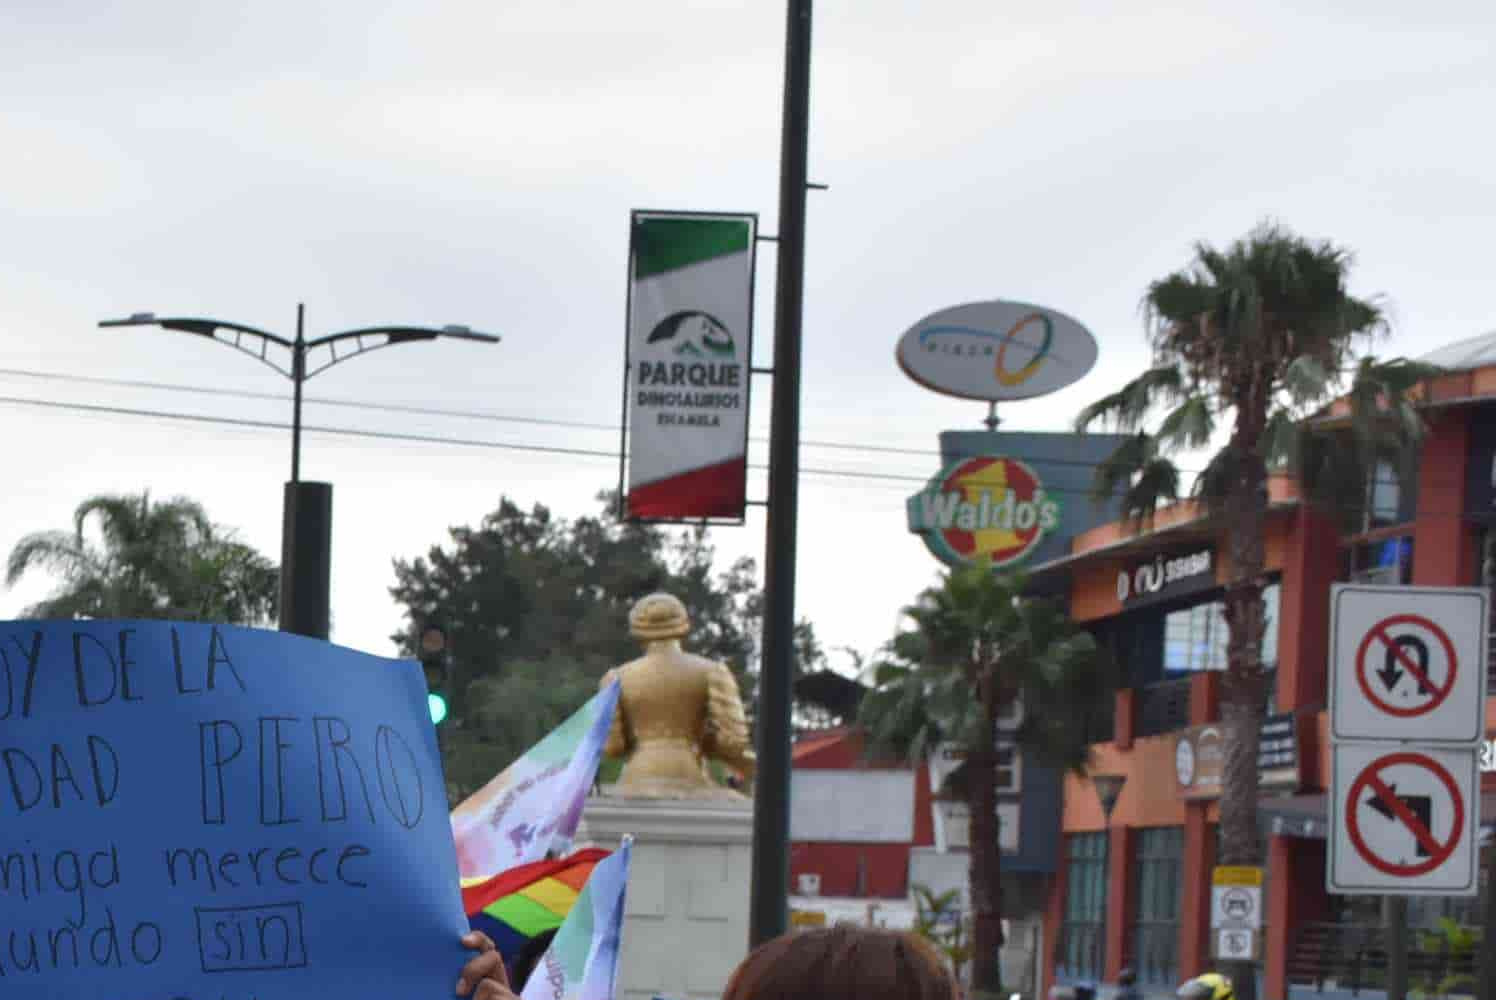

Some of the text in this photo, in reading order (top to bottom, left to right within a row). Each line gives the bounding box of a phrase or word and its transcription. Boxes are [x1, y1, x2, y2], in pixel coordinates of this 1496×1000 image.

[638, 362, 741, 388] PARQUE
[920, 490, 1059, 529] Waldo's
[73, 630, 143, 707] DE
[171, 626, 246, 693] LA
[200, 716, 423, 830] PERO
[166, 845, 370, 891] merece
[208, 909, 289, 965] sin
